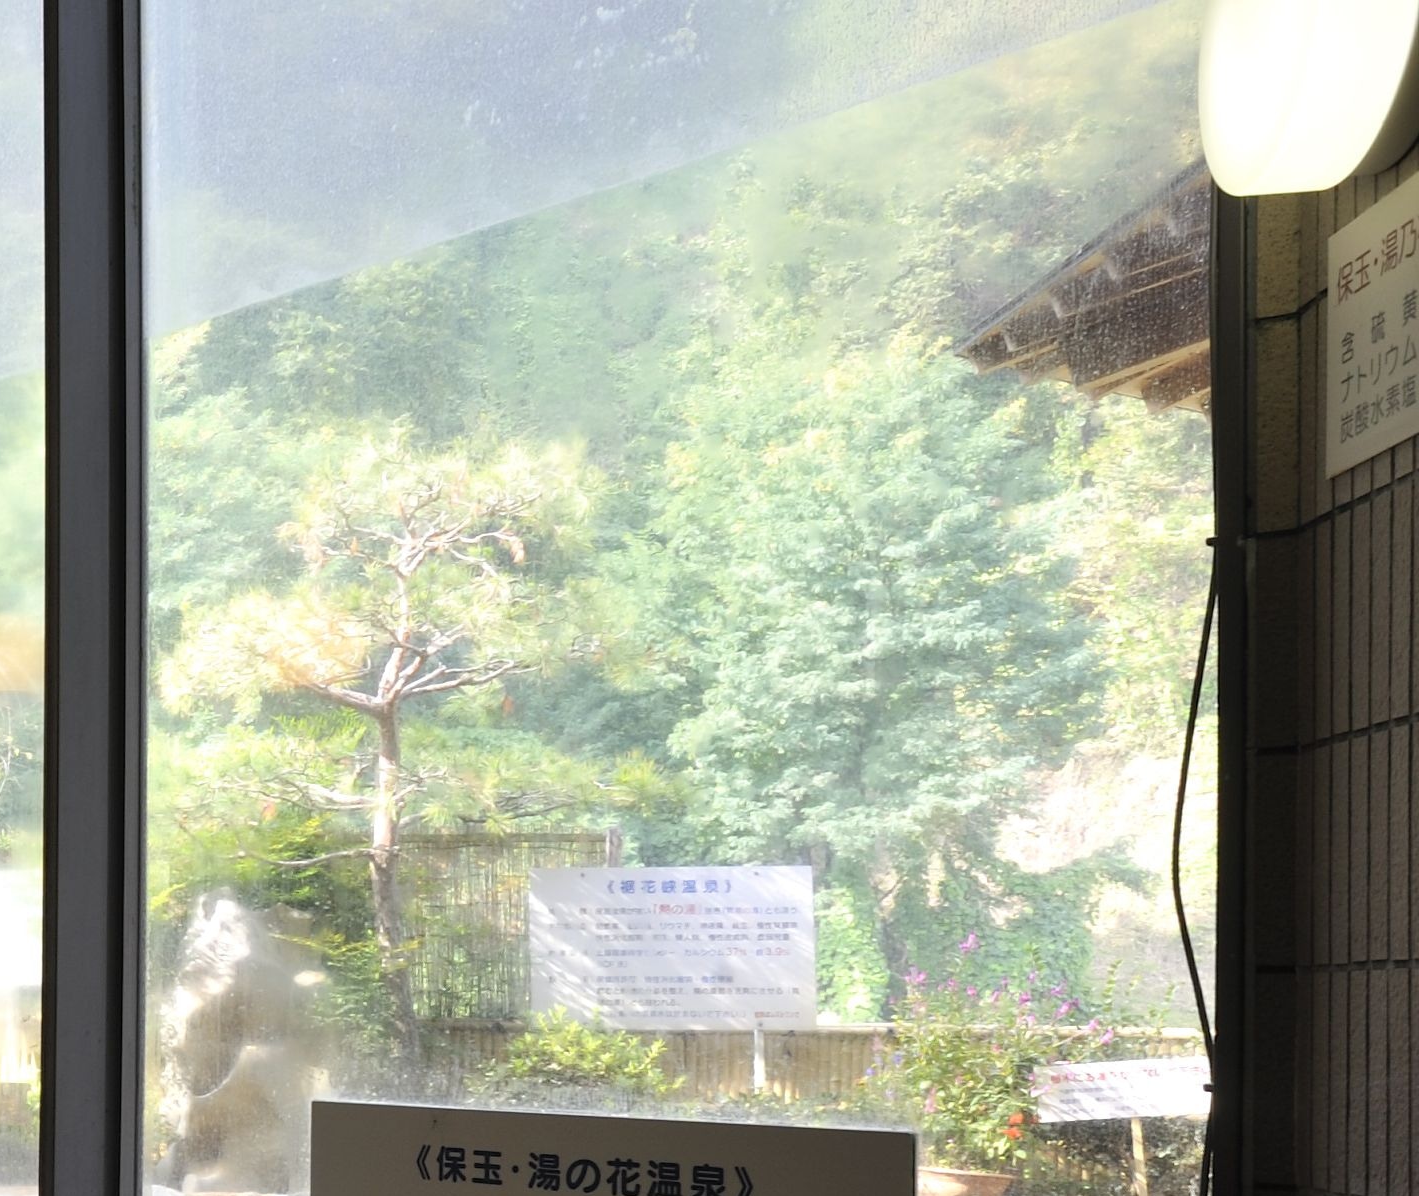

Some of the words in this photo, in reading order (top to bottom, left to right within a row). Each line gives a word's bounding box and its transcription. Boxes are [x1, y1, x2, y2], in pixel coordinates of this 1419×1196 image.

[1337, 215, 1419, 304] 保玉・湯乃
[1341, 335, 1417, 403] ナトリウム
[1340, 375, 1417, 444] 炭酸水素塩
